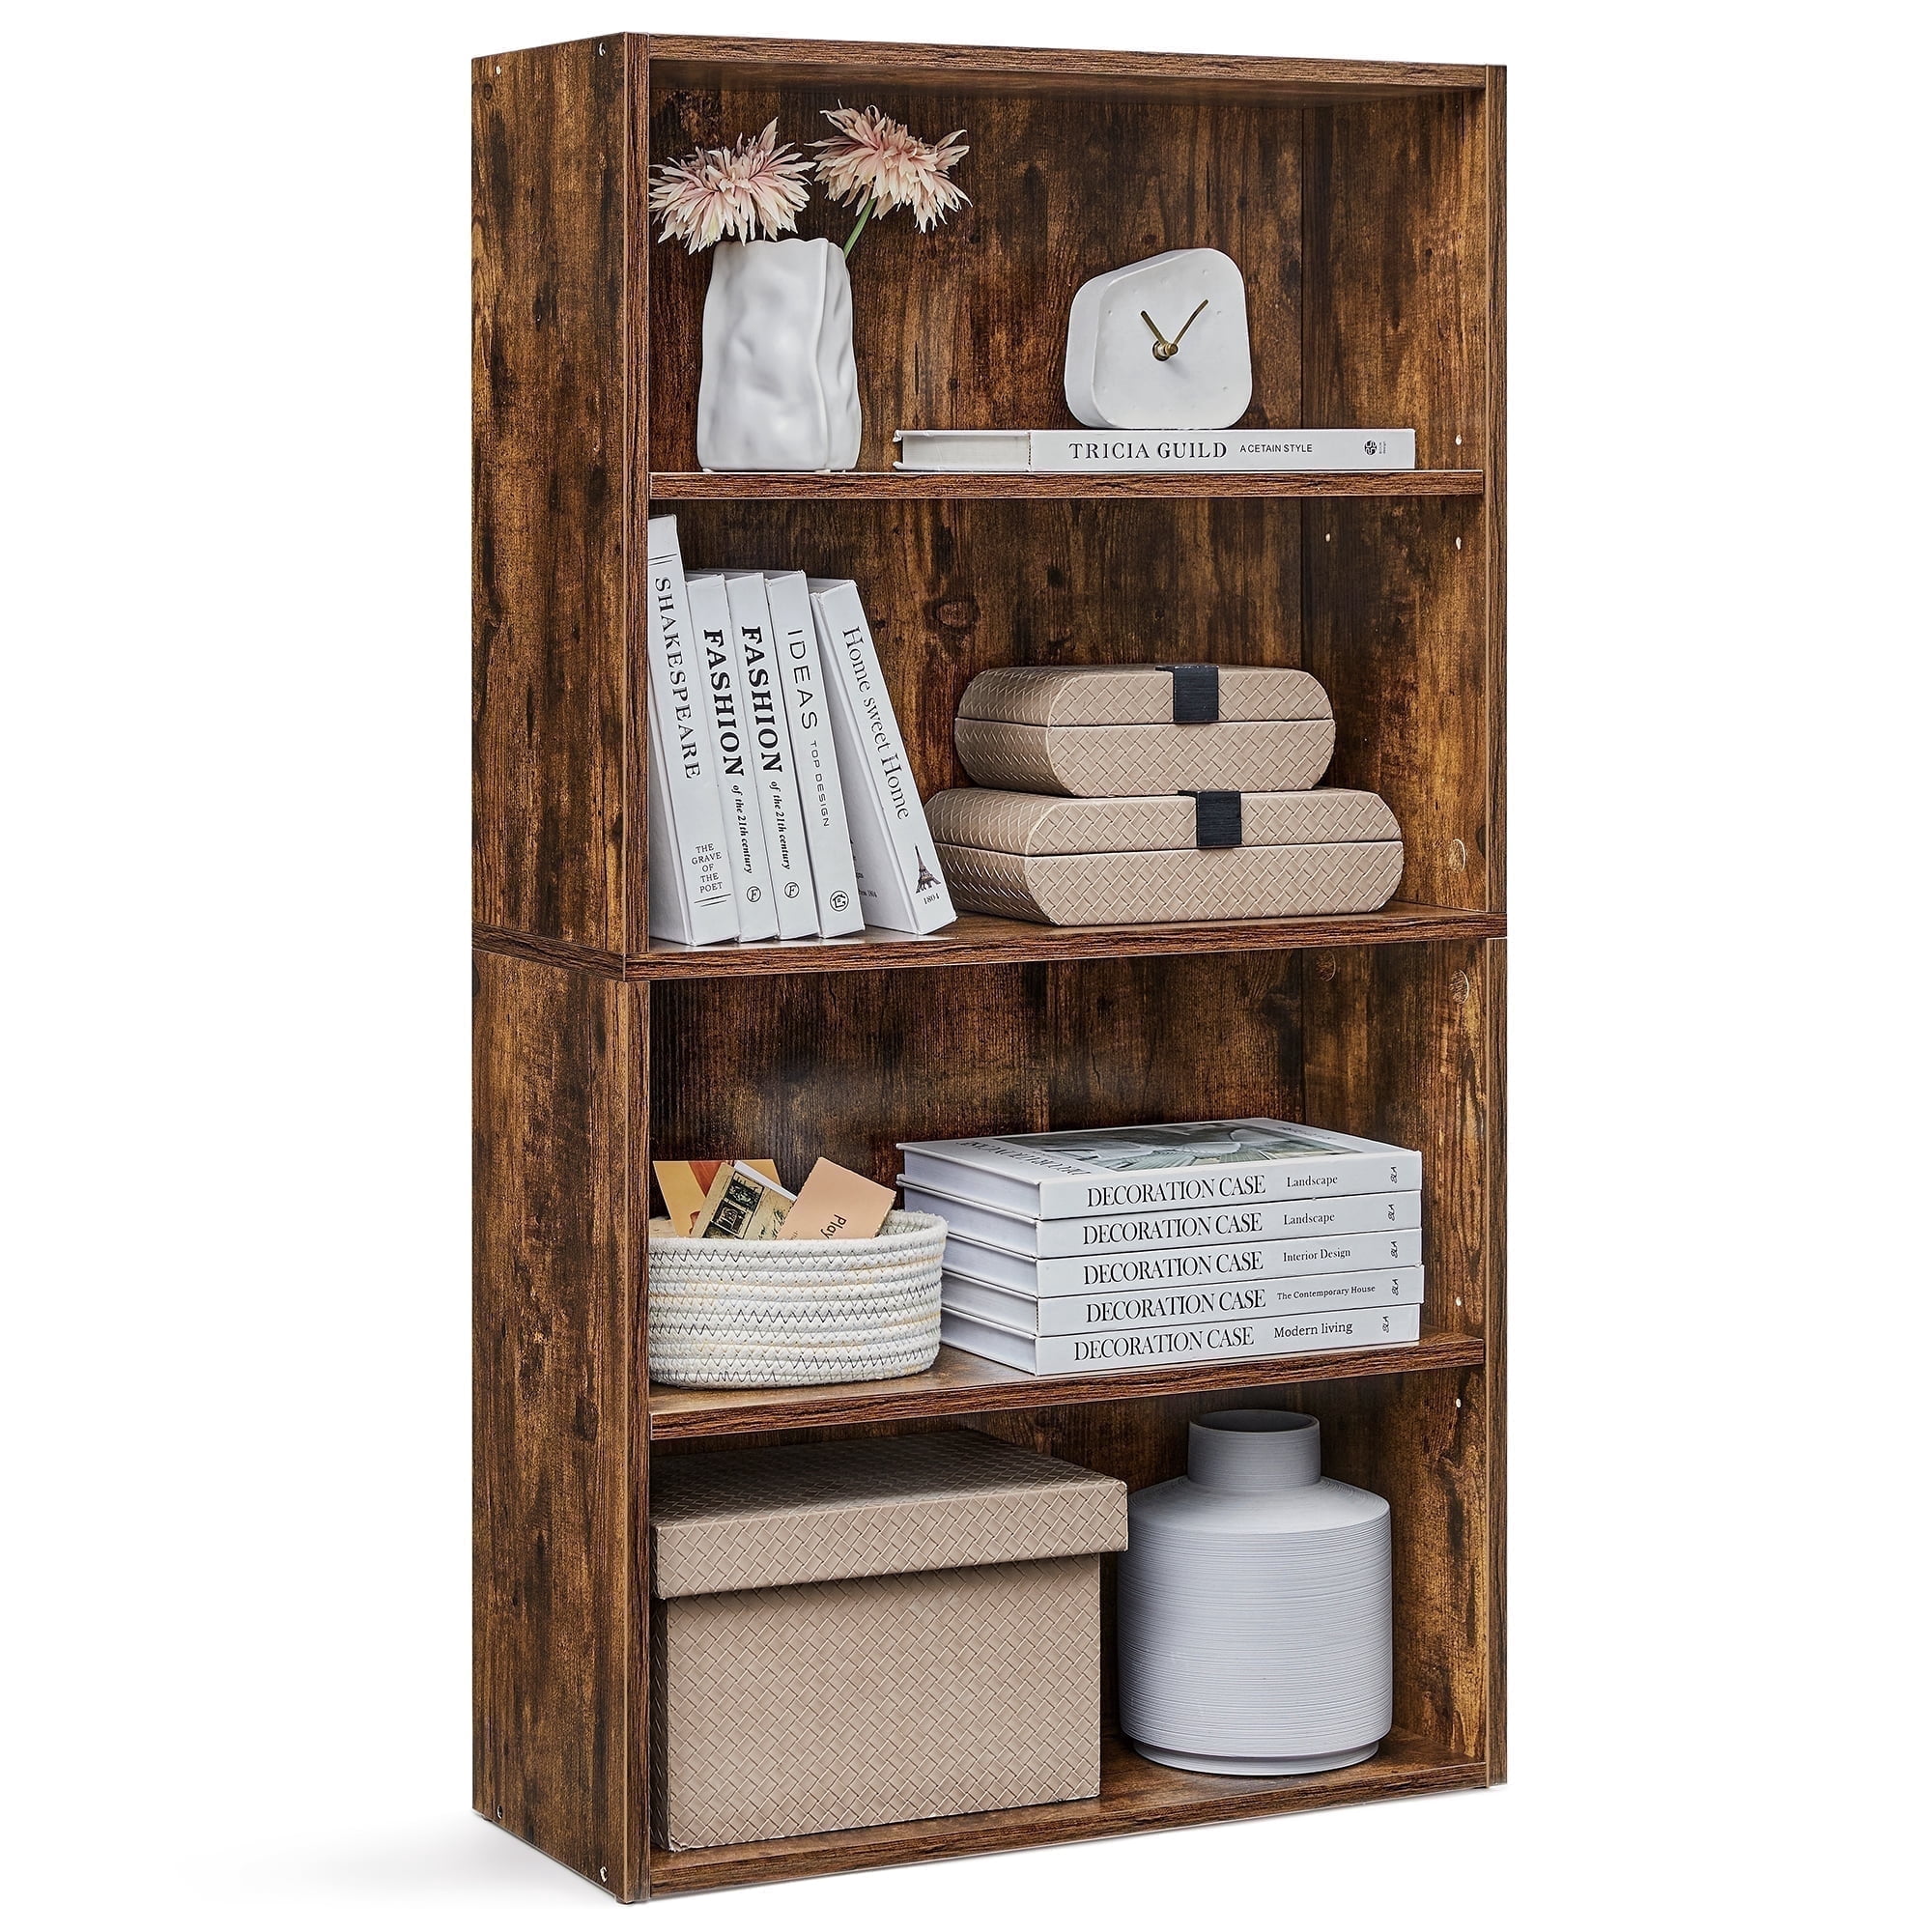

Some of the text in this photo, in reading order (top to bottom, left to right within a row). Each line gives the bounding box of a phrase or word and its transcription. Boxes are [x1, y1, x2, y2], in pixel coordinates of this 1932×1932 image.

[1068, 441, 1151, 459] TRICIA
[1157, 441, 1227, 459] GUILD
[1283, 443, 1313, 453] STYLE
[655, 577, 701, 780] SHAKESPEARE
[703, 629, 745, 777] FASHION
[741, 625, 782, 773] FASHION
[787, 629, 830, 827] IDEAS TOP DESIGN
[842, 625, 910, 820] Home sweet Home
[731, 784, 743, 796] of
[769, 781, 781, 792] of
[773, 794, 782, 810] the
[735, 799, 745, 813] the
[691, 851, 723, 865] GRAVE
[696, 843, 715, 854] THE
[741, 838, 753, 874] century
[779, 834, 790, 869] century
[700, 872, 720, 883] THE
[701, 863, 715, 872] OF
[699, 881, 723, 894] POET
[1087, 1178, 1215, 1208] DECORATION
[1219, 1175, 1265, 1196] CASE
[1287, 1175, 1338, 1188] Landscape
[820, 1214, 847, 1239] Play
[1083, 1216, 1211, 1245] DECORATION
[1215, 1212, 1263, 1234] CASE
[1283, 1212, 1335, 1226] Landscape
[1083, 1255, 1212, 1285] DECORATION
[1215, 1251, 1264, 1274] CASE
[1283, 1251, 1319, 1263] Interior
[1320, 1248, 1351, 1262] Design
[1086, 1293, 1215, 1323] DECORATION
[1218, 1289, 1266, 1310] CASE
[1277, 1292, 1293, 1300] The
[1293, 1287, 1349, 1300] Contemporary
[1350, 1284, 1376, 1294] House
[1074, 1330, 1203, 1361] DECORATION
[1207, 1326, 1255, 1349] CASE
[1273, 1325, 1319, 1339] Modern
[1321, 1321, 1353, 1336] living
